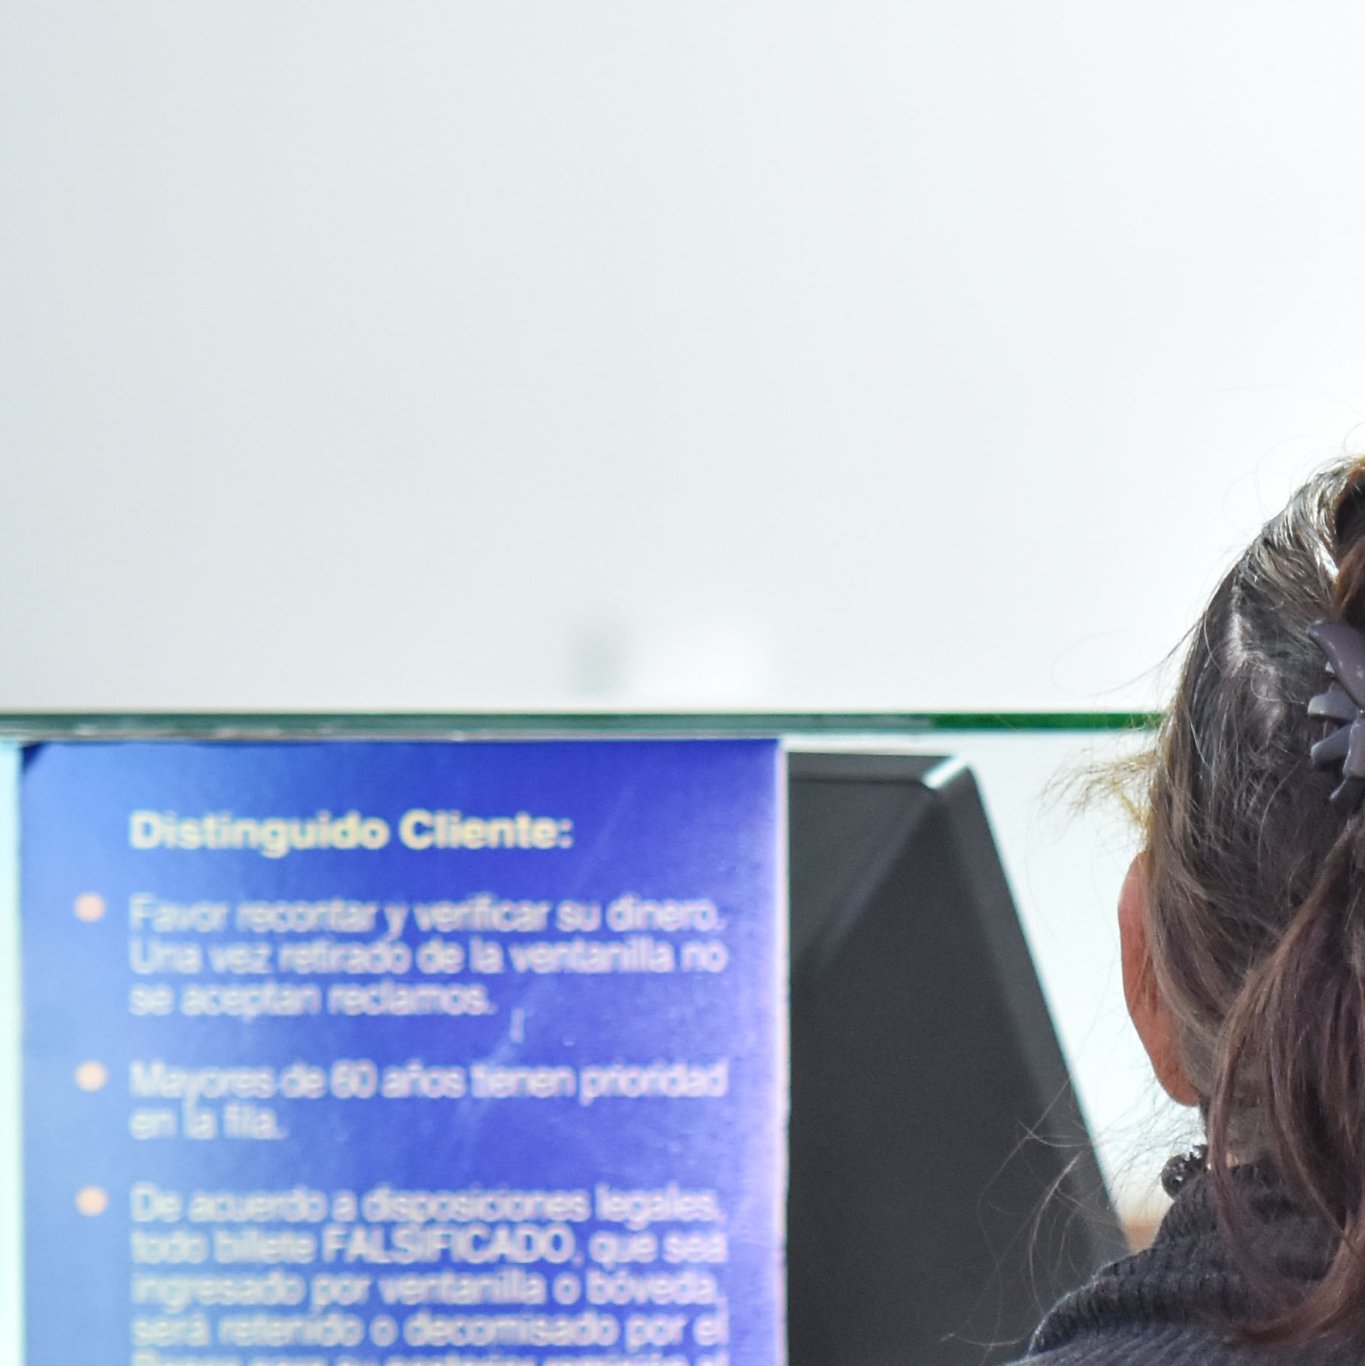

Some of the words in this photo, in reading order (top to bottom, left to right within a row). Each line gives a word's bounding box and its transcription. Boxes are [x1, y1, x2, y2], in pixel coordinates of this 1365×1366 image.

[129, 810, 391, 859] Distinguido
[400, 809, 575, 850] Cliente:
[129, 893, 229, 932] Favor
[382, 902, 409, 943] y
[413, 892, 551, 932] verificar
[556, 899, 600, 932] su
[129, 938, 202, 974] Una
[207, 942, 273, 974] vez
[277, 937, 411, 974] retirado
[416, 936, 464, 974] de
[469, 936, 503, 974] la
[508, 936, 674, 974] ventanilla
[680, 942, 727, 973] no
[129, 982, 174, 1016] se
[180, 979, 321, 1023] aceptan
[326, 978, 497, 1016] reclamos.
[128, 1060, 276, 1106] Mayores
[278, 1061, 326, 1099] de
[330, 1059, 378, 1099] 60
[381, 1058, 466, 1099] años
[469, 1062, 576, 1099] tienen
[579, 1058, 728, 1106] prioridad
[129, 1108, 178, 1140] en
[183, 1102, 217, 1140] la
[223, 1102, 288, 1140] fila.
[130, 1182, 184, 1223] De
[188, 1185, 329, 1223] acuerdo
[332, 1190, 358, 1223] a
[362, 1182, 592, 1228] disposiciones
[131, 1226, 209, 1264] todo
[212, 1226, 318, 1264] billete
[588, 1230, 659, 1270] que
[663, 1230, 728, 1264] sea
[131, 1269, 307, 1315] ingresado
[311, 1273, 370, 1316] por
[376, 1268, 547, 1305] ventanilla
[552, 1272, 582, 1305] o
[131, 1312, 210, 1347] será
[217, 1311, 365, 1347] retenido
[369, 1315, 399, 1347] o
[403, 1308, 621, 1347] decomisado
[625, 1313, 688, 1352] por
[693, 1307, 729, 1346] el
